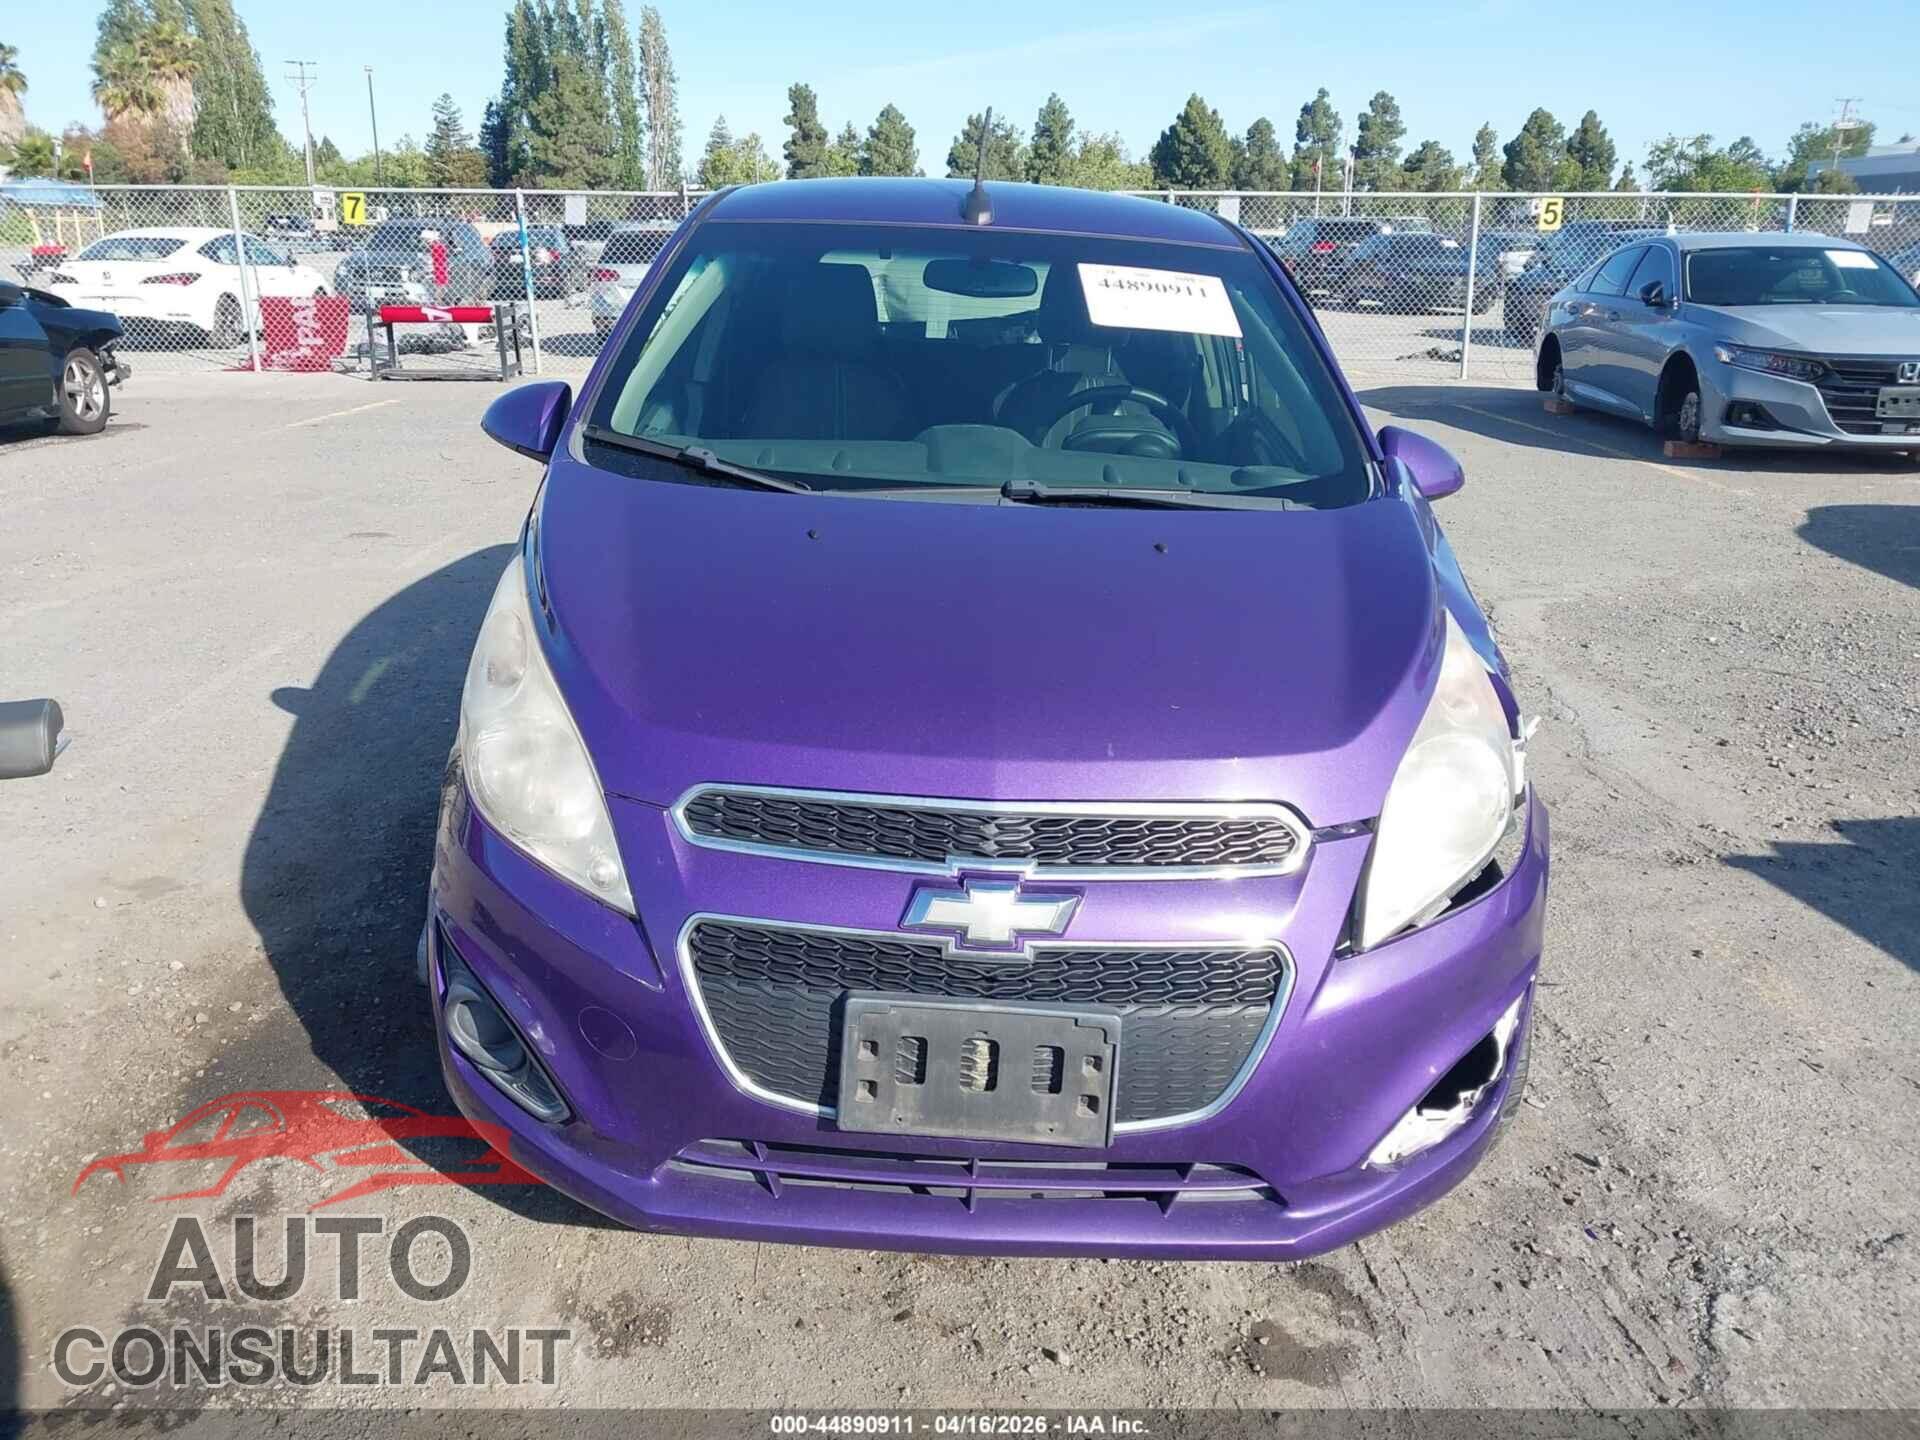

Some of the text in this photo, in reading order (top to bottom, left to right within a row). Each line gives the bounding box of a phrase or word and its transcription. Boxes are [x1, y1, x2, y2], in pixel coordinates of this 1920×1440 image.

[346, 195, 361, 219] 7
[1543, 201, 1558, 225] 5
[1097, 278, 1208, 298] 44890911
